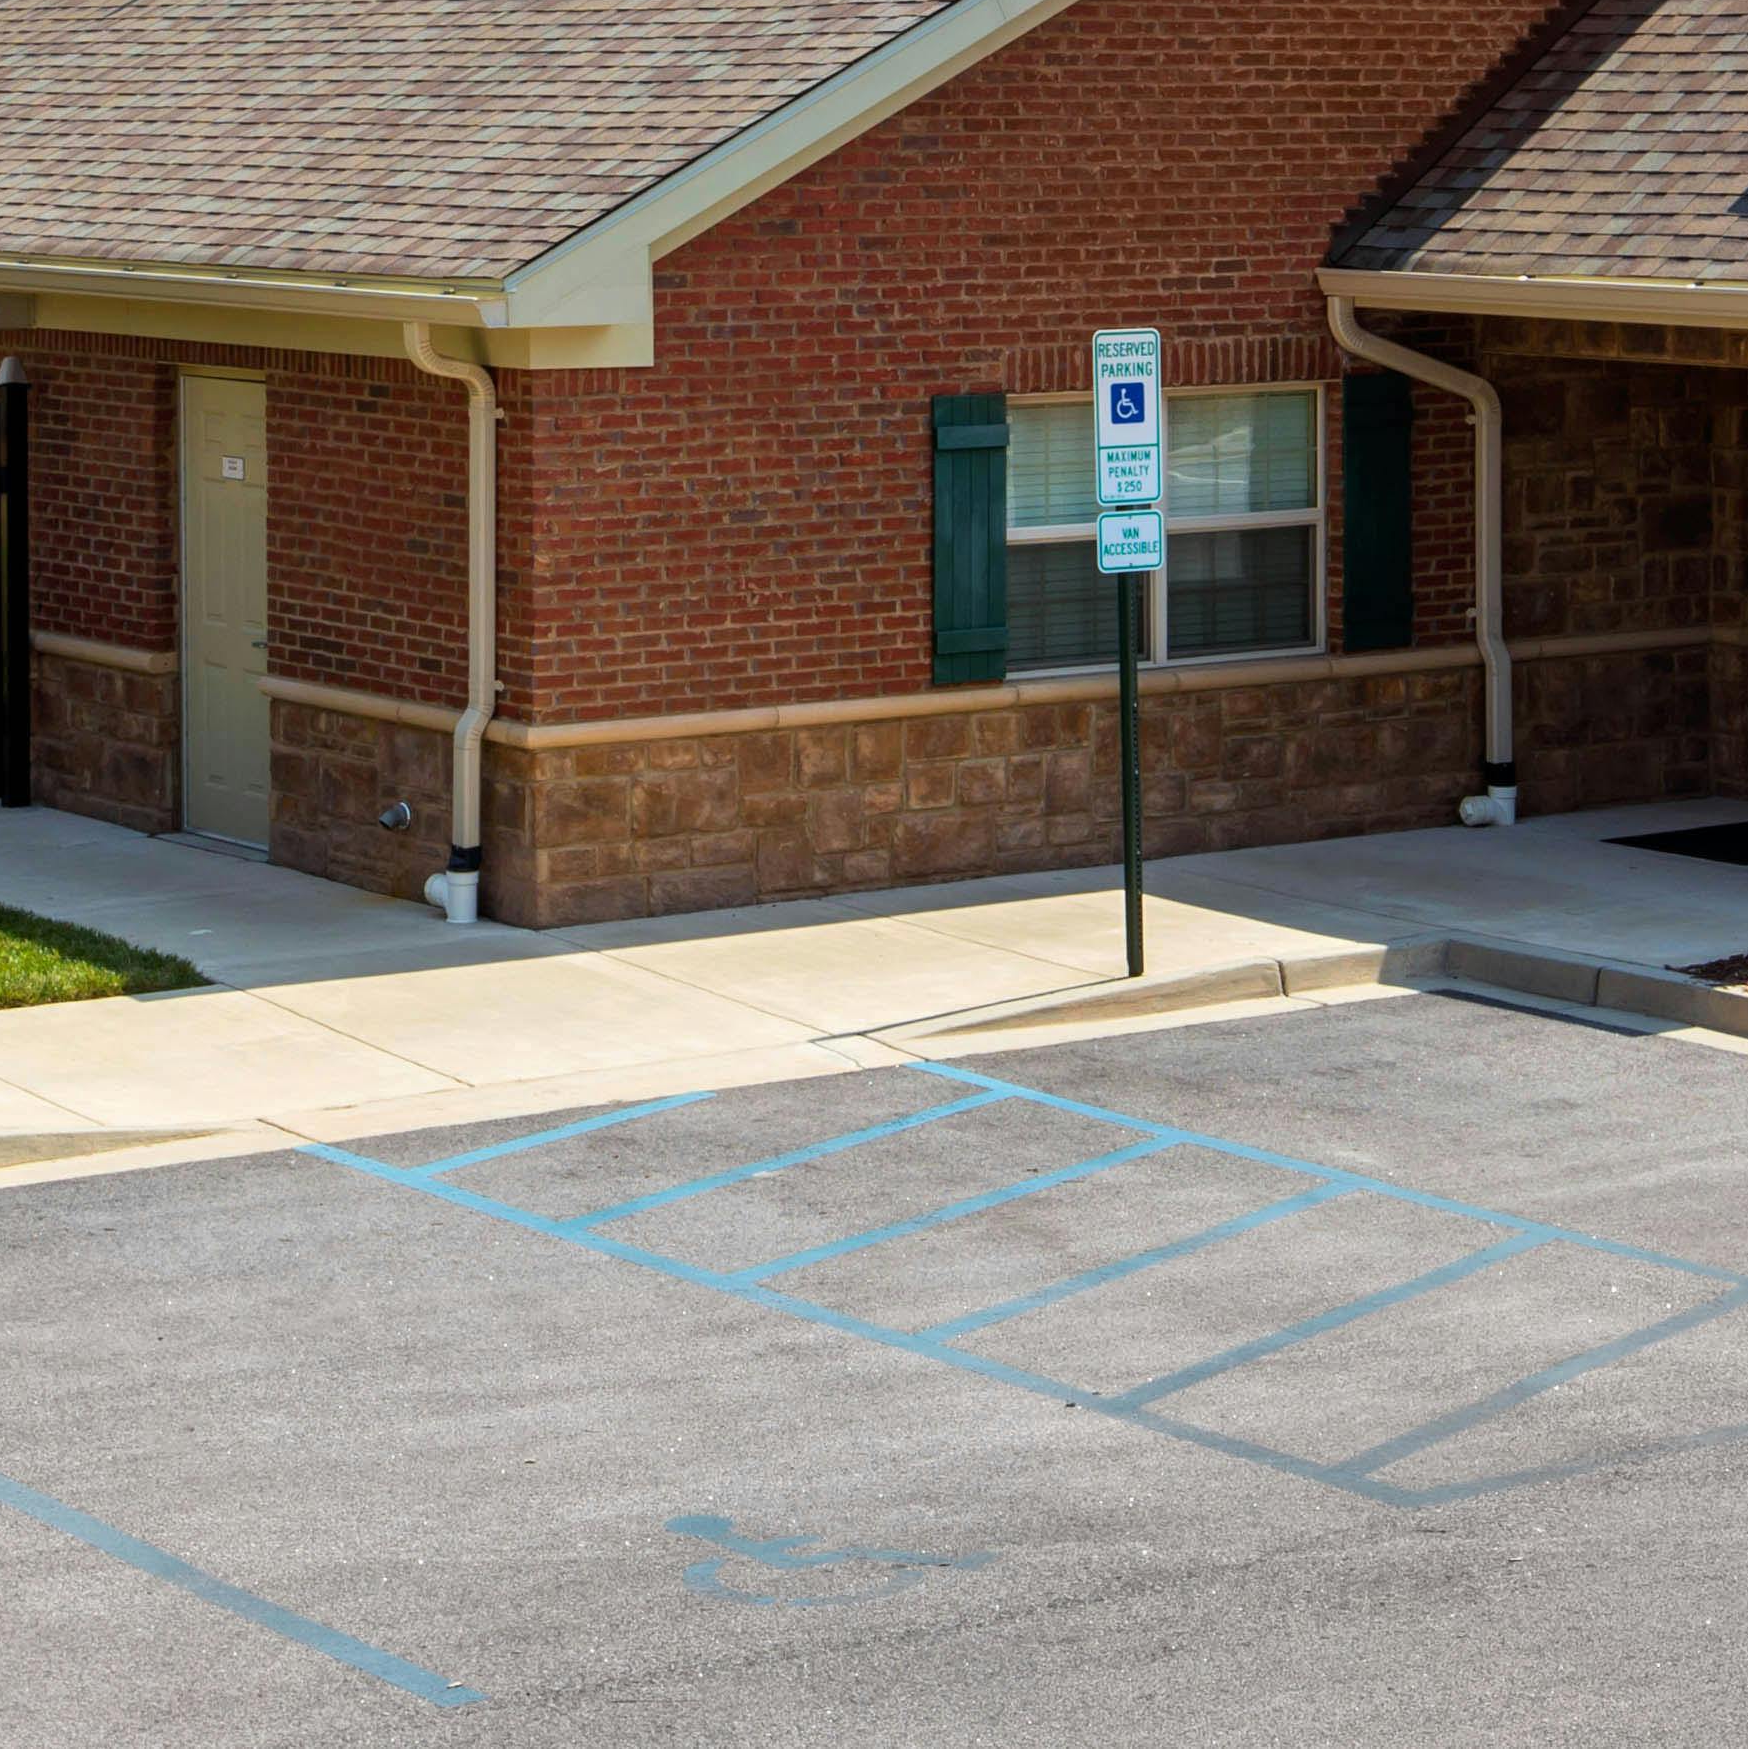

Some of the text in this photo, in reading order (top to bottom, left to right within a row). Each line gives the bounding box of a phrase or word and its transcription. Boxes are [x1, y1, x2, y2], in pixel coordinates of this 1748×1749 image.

[1098, 341, 1155, 358] RESERVED
[1101, 362, 1153, 378] PARKING
[1107, 450, 1151, 463] MAXIMUM
[1108, 465, 1149, 478] PENALTY
[1122, 528, 1140, 540] VAN
[1103, 540, 1159, 556] ACCESSIBLE
